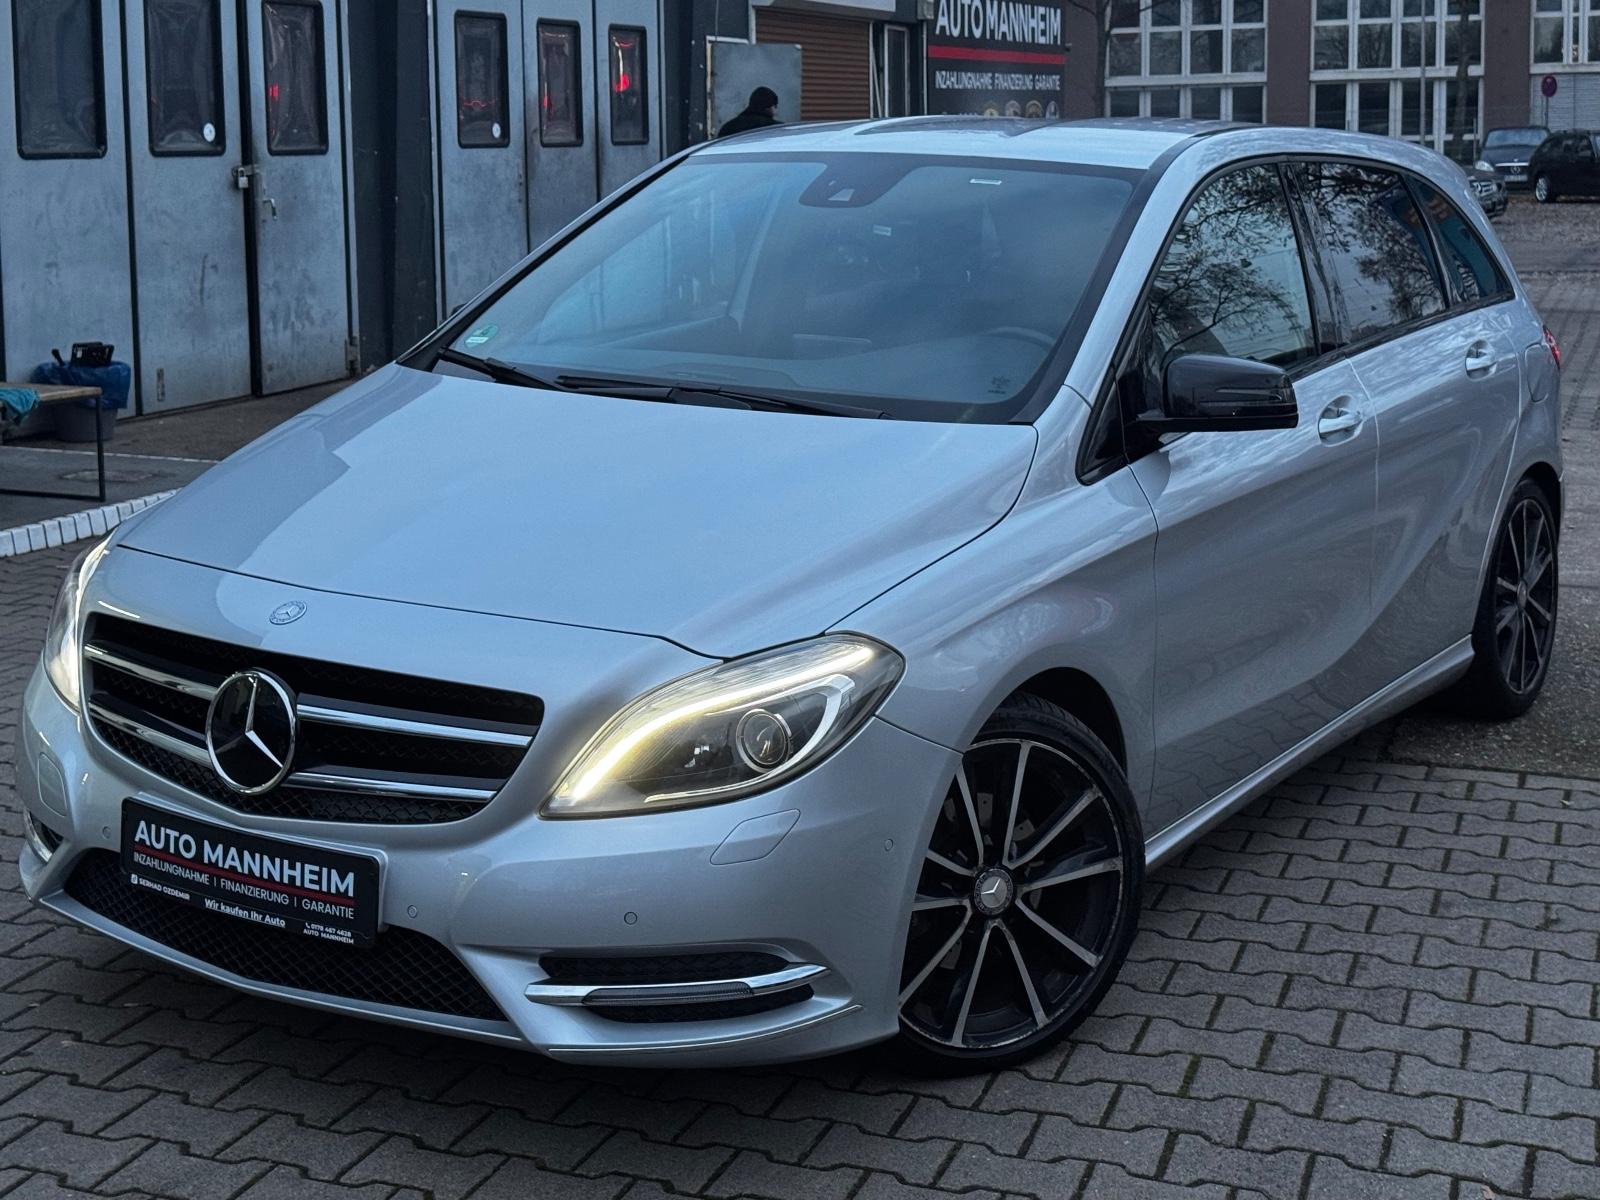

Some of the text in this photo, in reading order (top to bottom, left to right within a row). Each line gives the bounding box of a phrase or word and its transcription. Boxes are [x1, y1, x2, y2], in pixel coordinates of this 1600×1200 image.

[935, 0, 1061, 45] AUTO MANNHEIM
[134, 820, 355, 897] AUTO MANNHEIM
[133, 851, 354, 919] INZAHLUNGNAHME FINANZIERUNG GARANTIE
[204, 898, 286, 927] Wir kaufen Ihr Auto
[303, 928, 319, 937] AUTO
